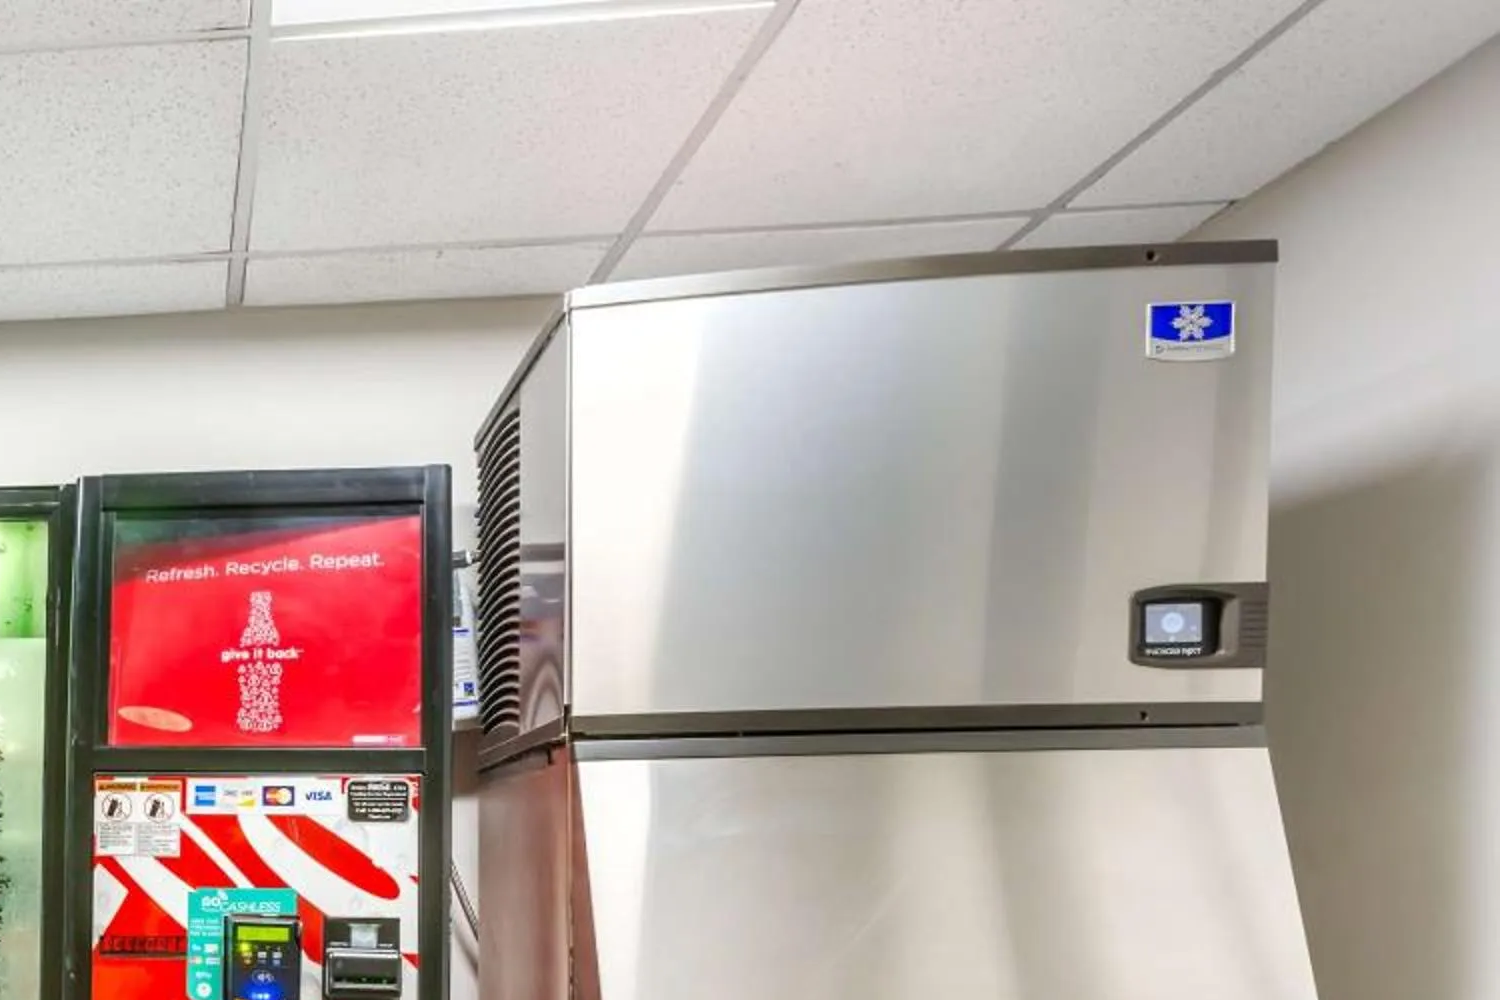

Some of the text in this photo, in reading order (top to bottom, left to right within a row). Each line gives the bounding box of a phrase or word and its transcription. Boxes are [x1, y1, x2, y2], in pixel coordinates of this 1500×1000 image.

[146, 552, 384, 584] Refresh. Recycle. Repeat.
[305, 791, 333, 802] VISA
